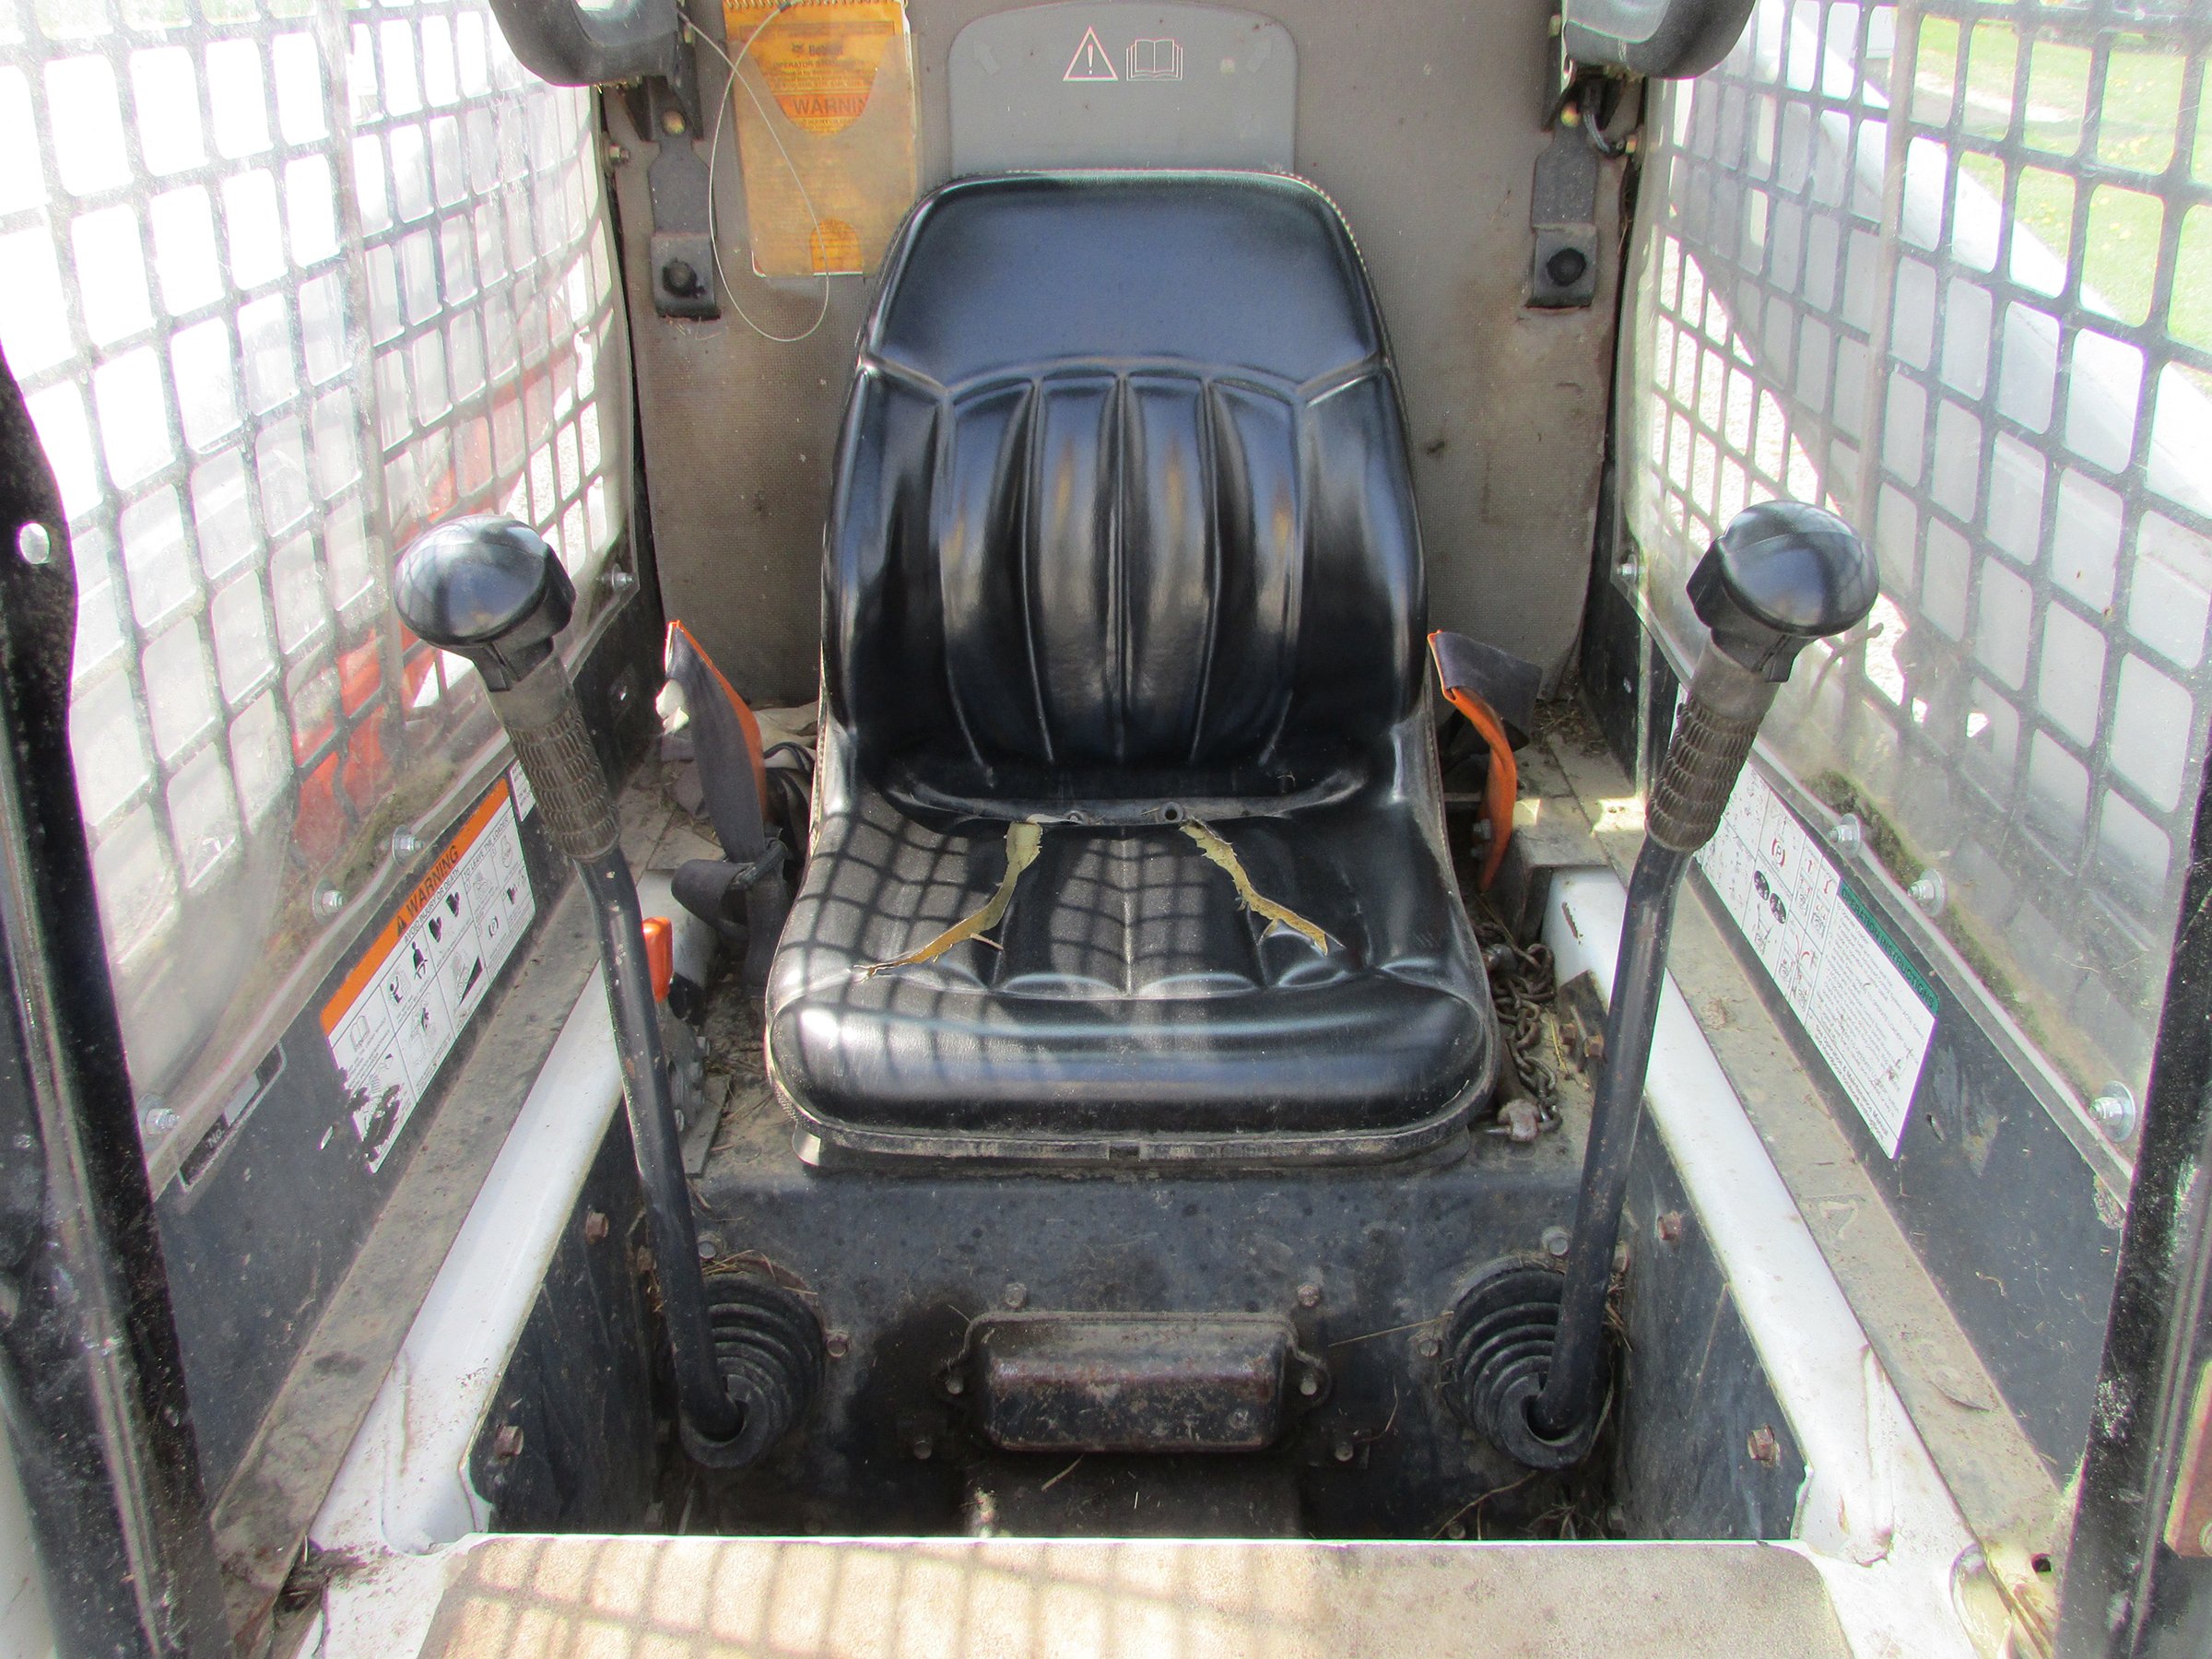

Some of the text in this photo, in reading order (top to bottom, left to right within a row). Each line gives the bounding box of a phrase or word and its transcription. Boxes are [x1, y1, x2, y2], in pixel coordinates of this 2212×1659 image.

[406, 844, 459, 918] WARNING
[419, 896, 437, 923] INJURY
[443, 866, 460, 890] DEATH
[1841, 888, 1881, 941] OPERATION
[1880, 936, 1934, 1008] INSTRUCTIONS
